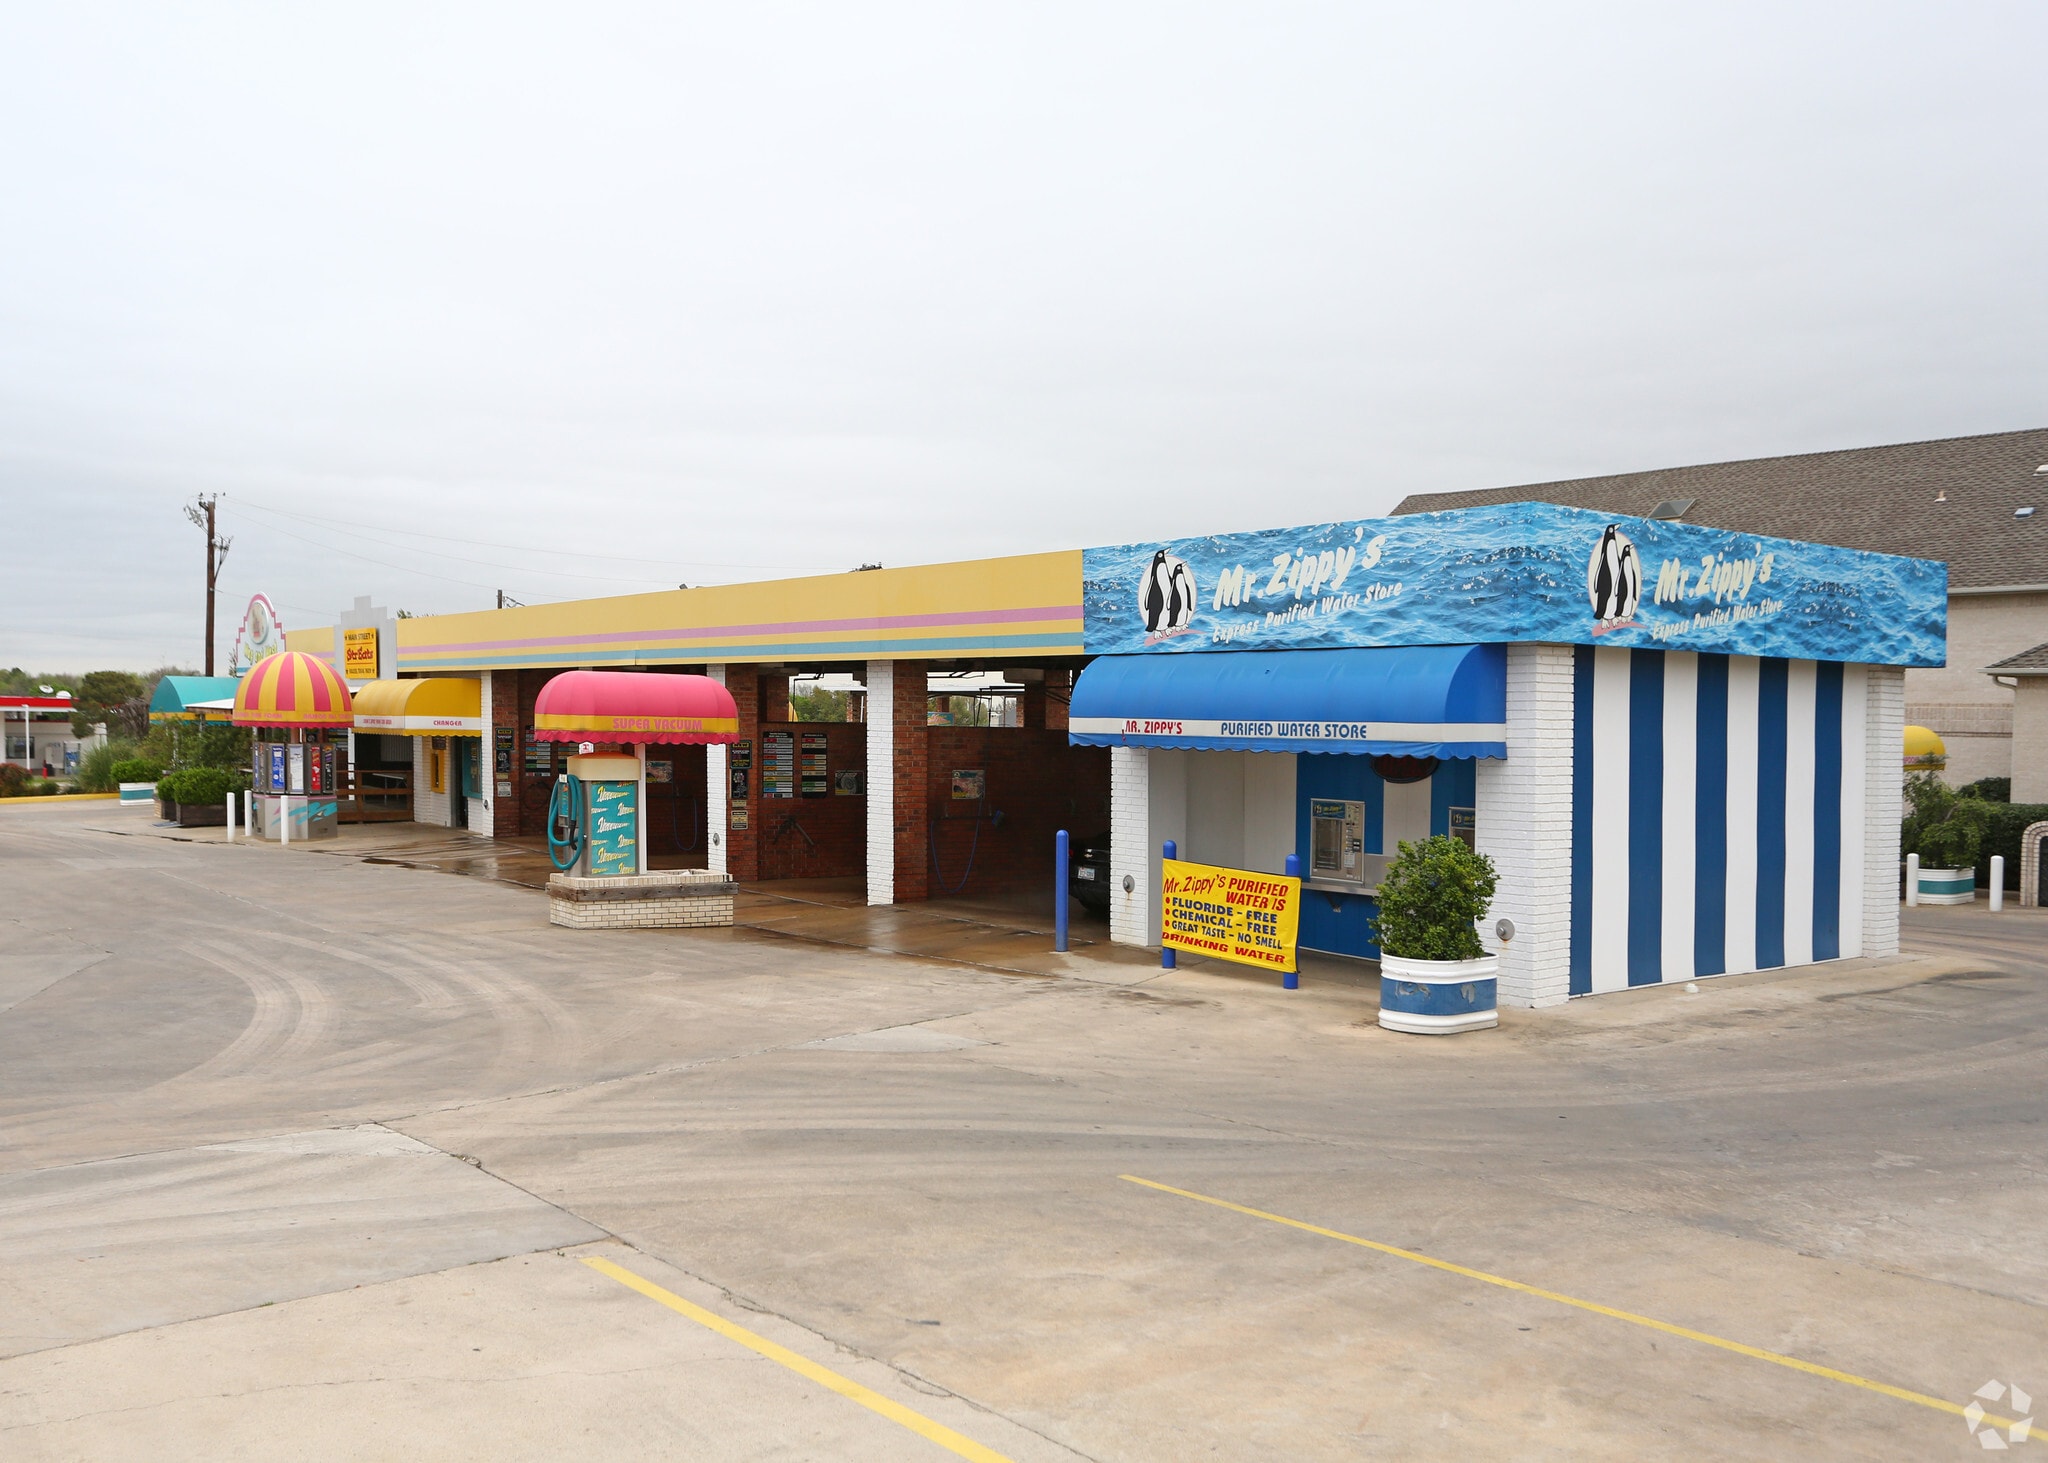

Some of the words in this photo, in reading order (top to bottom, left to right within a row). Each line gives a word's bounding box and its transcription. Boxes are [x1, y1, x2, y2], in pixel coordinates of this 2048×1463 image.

[1212, 563, 1264, 611] Mr.
[1266, 526, 1387, 601] Zippy's
[1653, 557, 1695, 606] Mr.
[1695, 541, 1775, 605] Zippy's
[1212, 619, 1260, 643] Express
[1264, 600, 1318, 629] Purified
[1321, 591, 1361, 615] Water
[1364, 581, 1403, 604] Store
[1652, 619, 1690, 643] Express
[1693, 607, 1731, 630] Purified
[1733, 601, 1759, 622] Water
[1760, 597, 1784, 617] Store
[613, 717, 651, 730] SUPER
[654, 719, 703, 731] VACUUM
[1144, 720, 1183, 735] ZIPPY'S
[1220, 722, 1273, 736] PURIFIED
[1277, 722, 1320, 738] WATER
[1324, 723, 1368, 739] STORE
[1225, 891, 1269, 909] WATER
[1271, 898, 1287, 912] IS
[1228, 877, 1289, 897] PURIFIED
[1171, 908, 1233, 929] CHEMICAL
[1247, 922, 1277, 936] FREE
[1172, 896, 1234, 917] FLUORIDE
[1246, 910, 1278, 924] FREE
[1161, 931, 1229, 953] DRINKING
[1235, 946, 1286, 964] WATER
[1171, 920, 1199, 934] GREAT
[1201, 925, 1226, 939] TASTE
[1237, 932, 1252, 944] NO
[1255, 935, 1283, 950] SMELL
